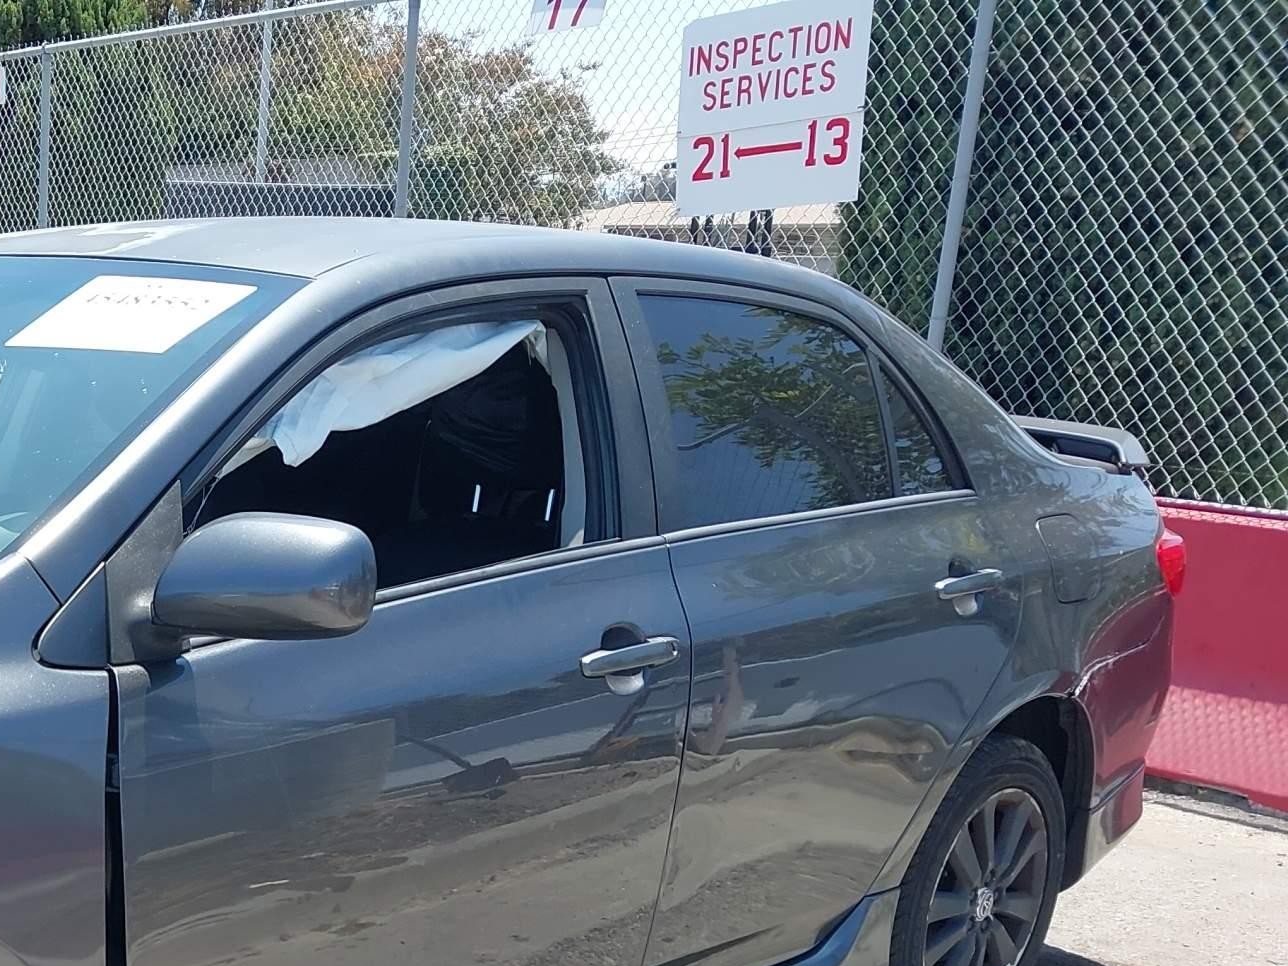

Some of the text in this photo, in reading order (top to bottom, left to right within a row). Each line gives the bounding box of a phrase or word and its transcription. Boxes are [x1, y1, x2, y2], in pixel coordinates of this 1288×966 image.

[688, 18, 853, 77] INSPECTION
[702, 60, 836, 112] SERVICES
[691, 117, 851, 182] 21 13
